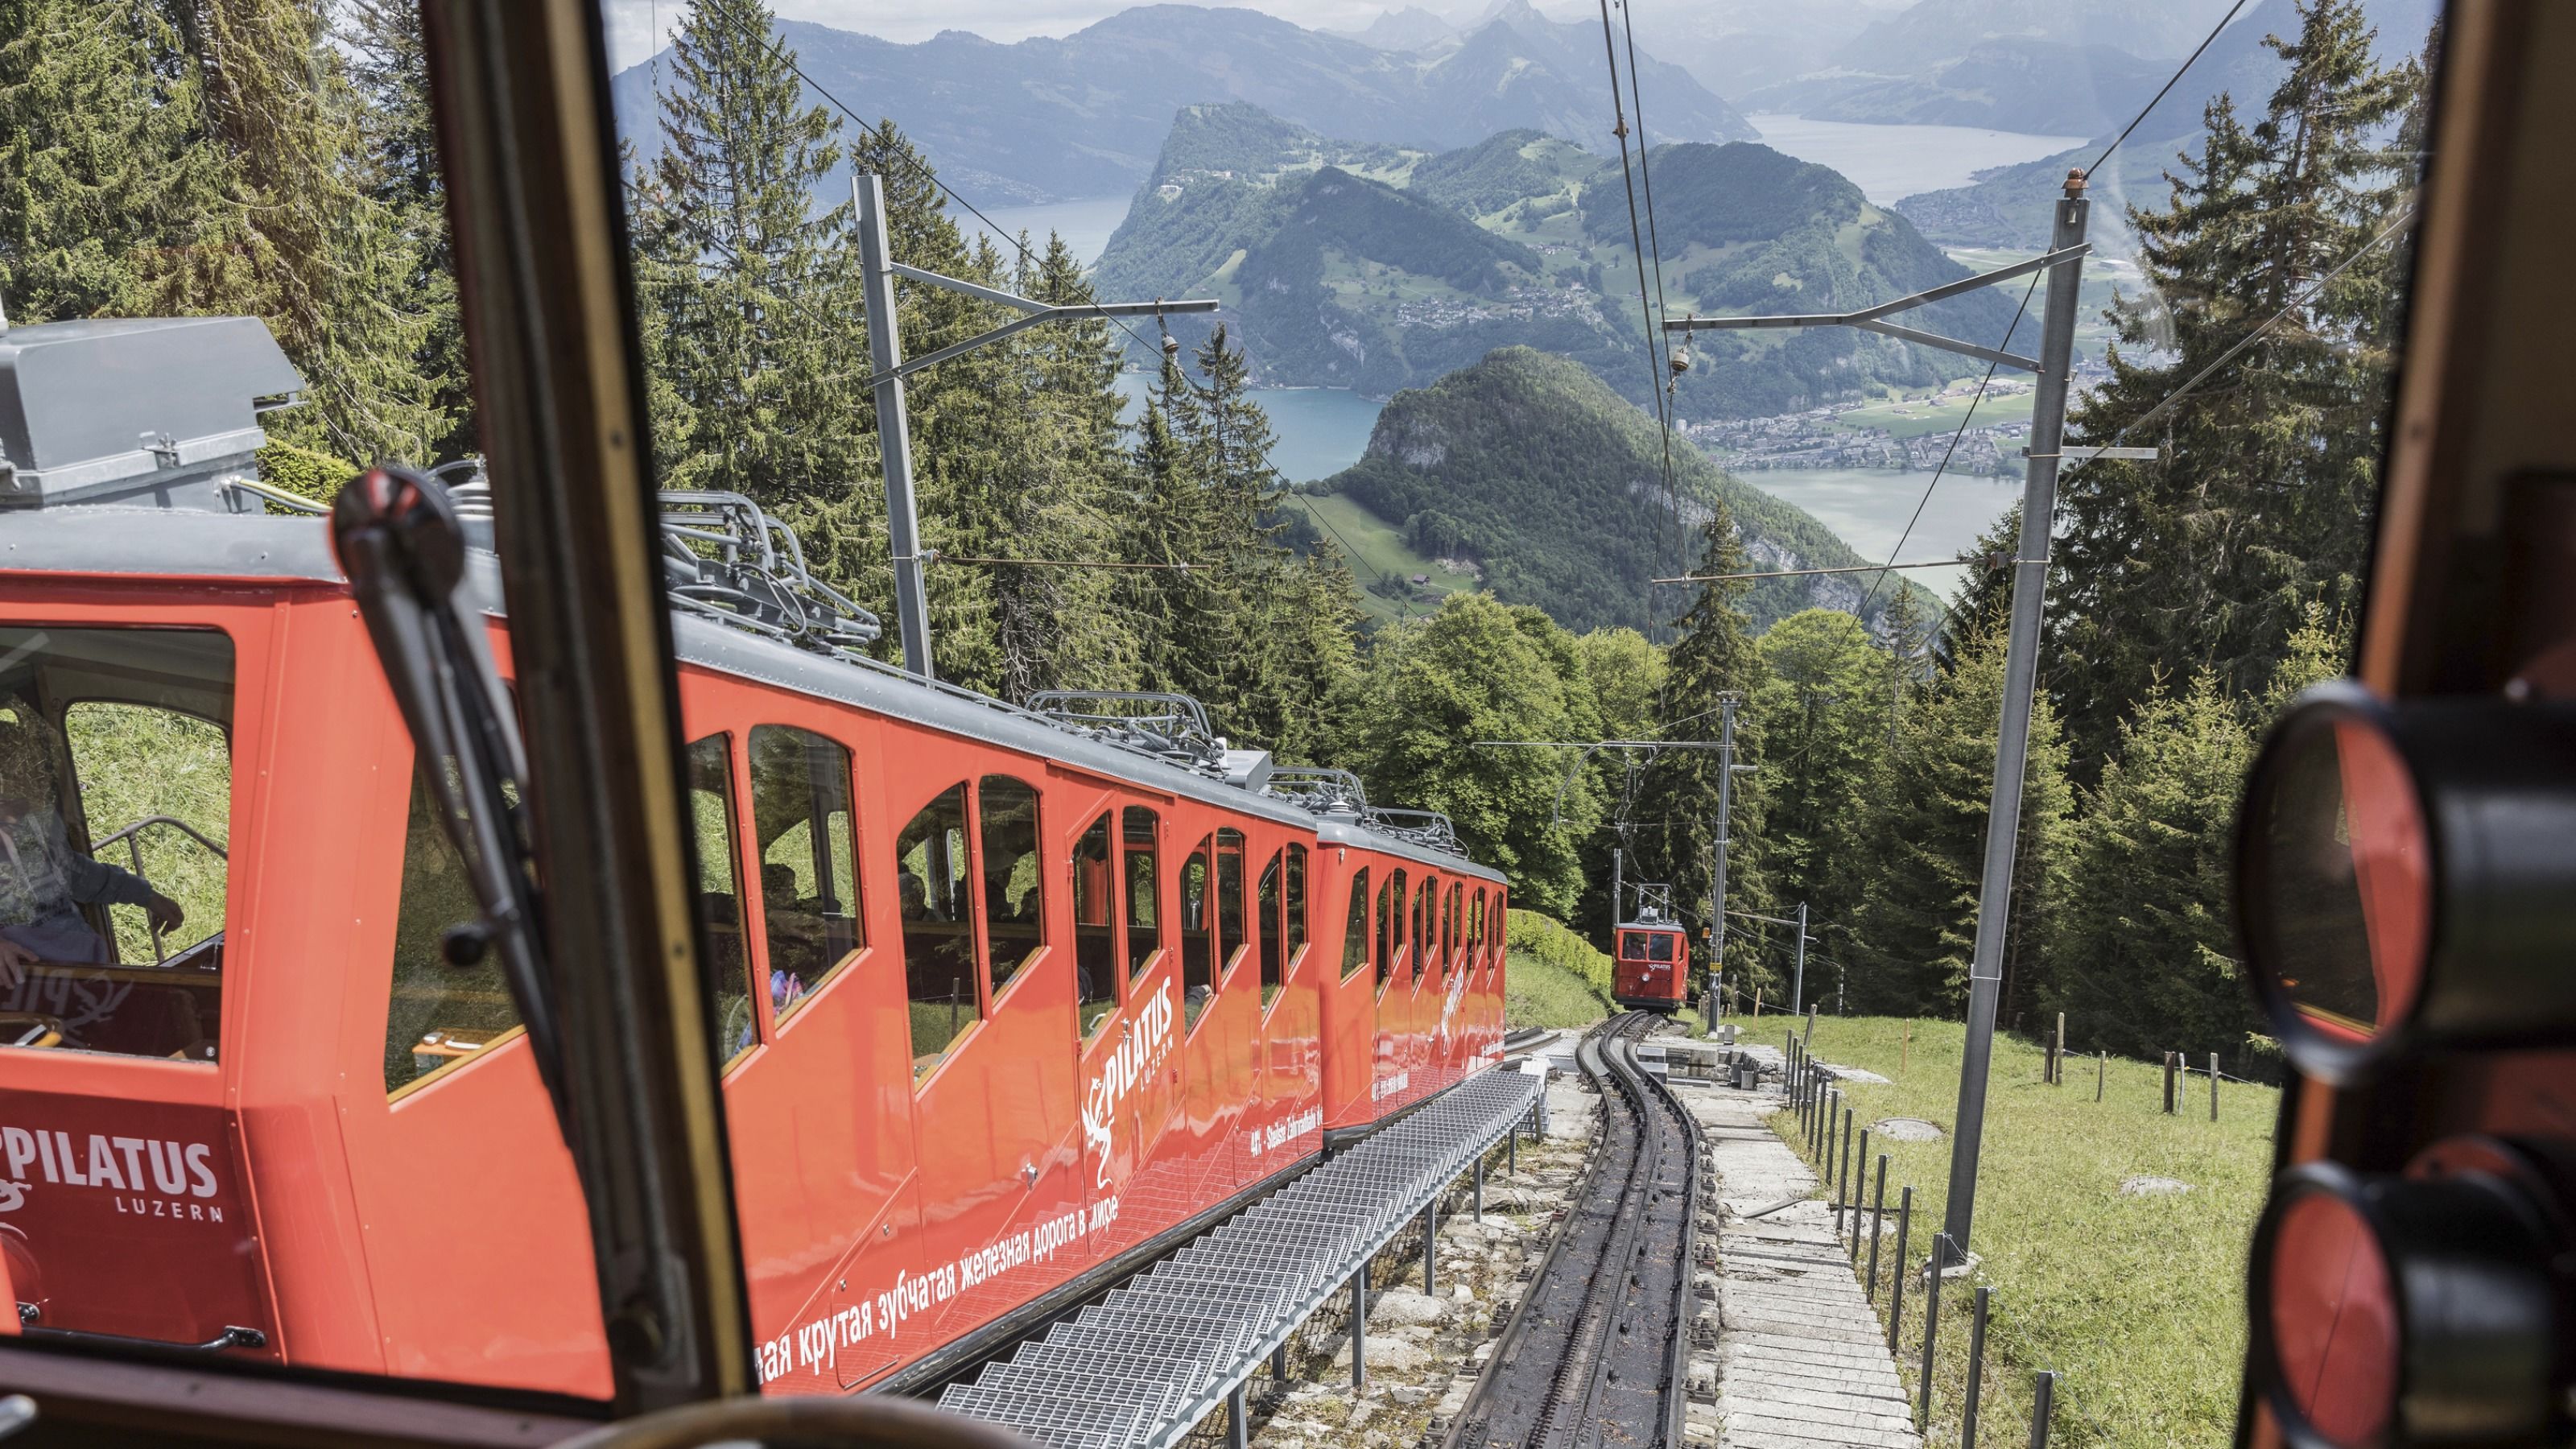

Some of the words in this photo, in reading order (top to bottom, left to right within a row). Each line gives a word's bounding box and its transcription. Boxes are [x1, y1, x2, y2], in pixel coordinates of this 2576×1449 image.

[1105, 976, 1172, 1117] PILATUS
[1141, 1034, 1173, 1093] LUZERN
[4, 1127, 217, 1198] PILATUS
[116, 1196, 224, 1223] LUZERN
[799, 1300, 873, 1376] крутая
[877, 1263, 956, 1340] зубчатая
[960, 1231, 1030, 1292] железная
[1034, 1212, 1075, 1265] дорога
[1079, 1209, 1086, 1237] в
